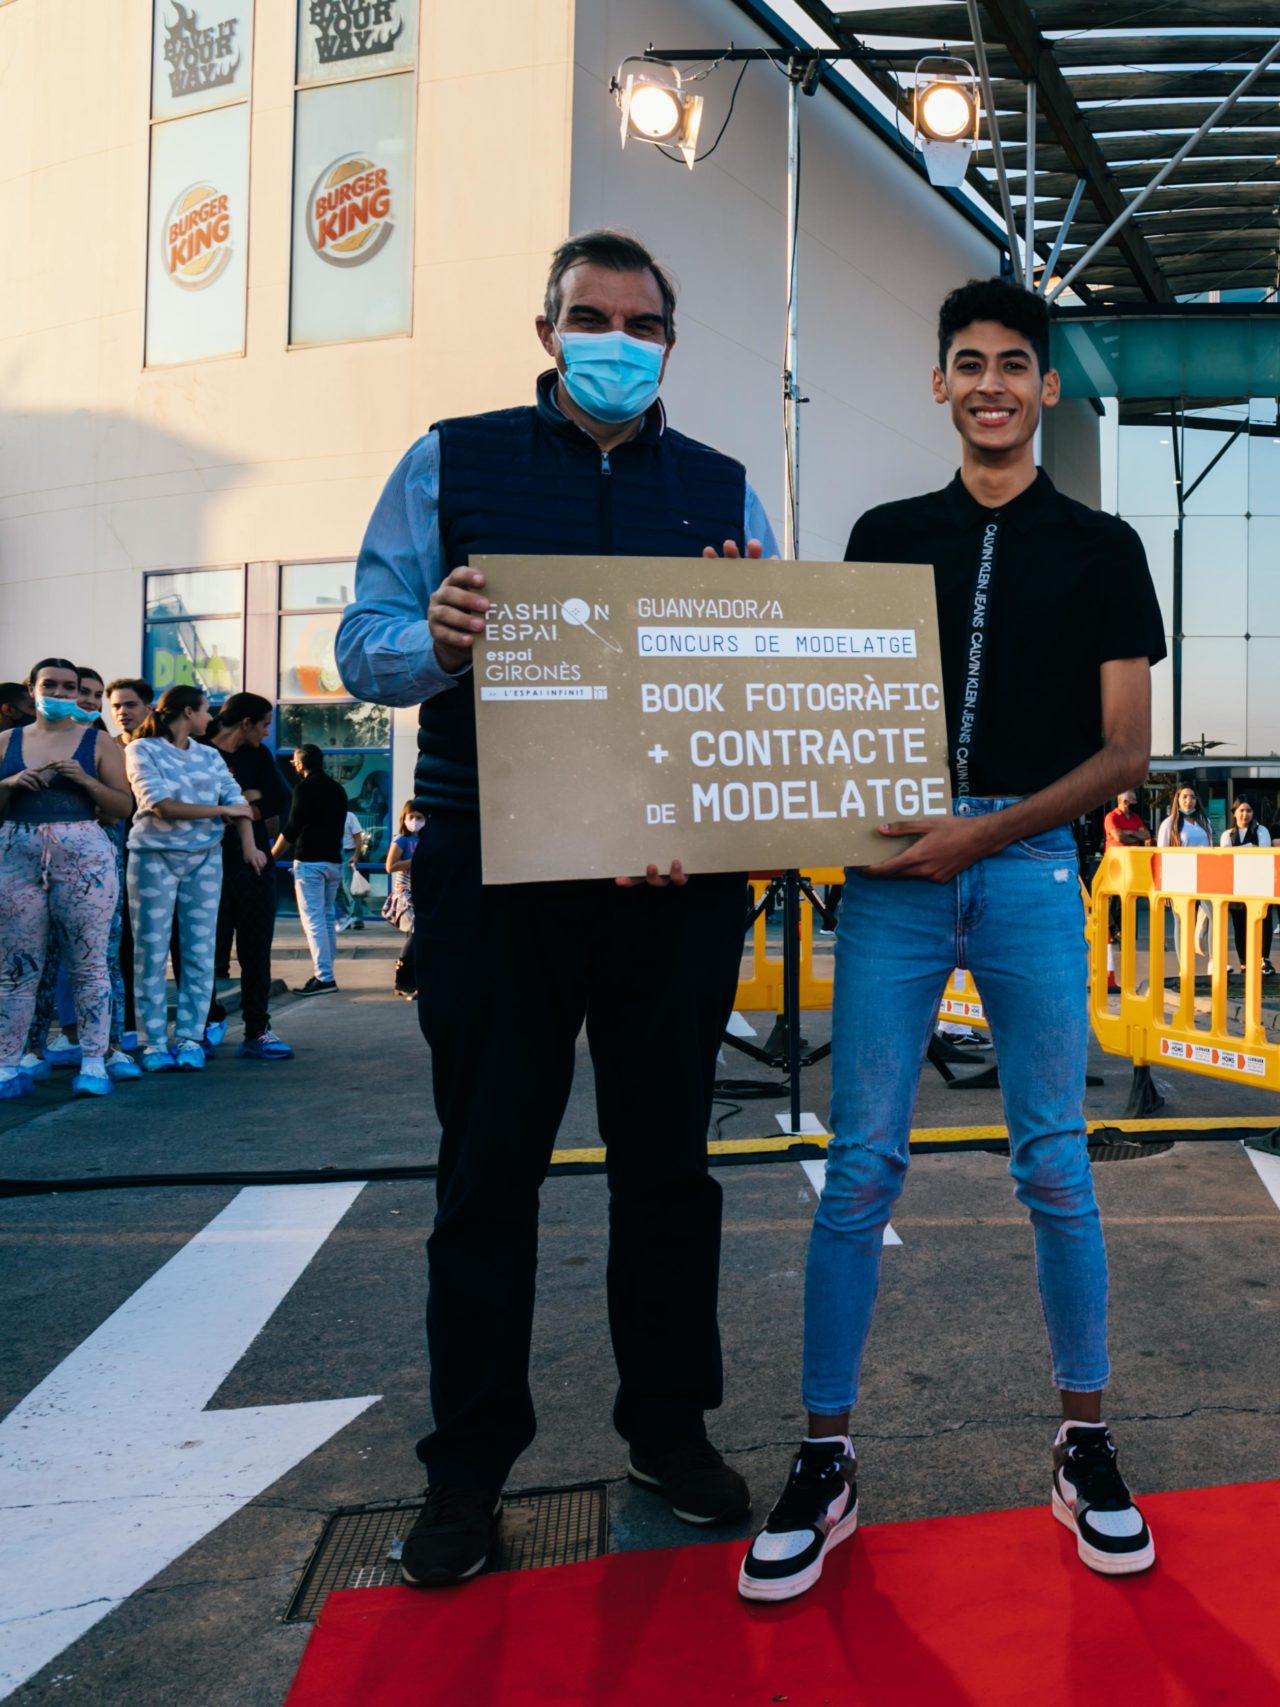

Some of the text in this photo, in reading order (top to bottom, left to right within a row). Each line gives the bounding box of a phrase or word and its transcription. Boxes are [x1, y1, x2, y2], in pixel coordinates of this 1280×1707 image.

[319, 0, 393, 38] YOUR
[164, 17, 238, 61] HAVE IT
[174, 36, 234, 73] YOUR
[315, 29, 374, 58] WAY
[168, 62, 217, 93] WAY
[315, 167, 387, 220] BURGER
[168, 194, 229, 246] BURGER
[317, 187, 391, 250] KING
[170, 213, 230, 273] KING
[981, 523, 998, 560] CALVIN
[976, 561, 992, 589] KLEIN
[637, 597, 784, 619] GUANYADOR/A
[971, 590, 987, 628] JEANS
[485, 624, 557, 641] ESPAI
[640, 634, 913, 654] CONCURS DE MODELATGE
[486, 648, 532, 664] espai
[486, 660, 582, 681] GIRONÈS
[968, 631, 983, 676] CALVIN
[504, 688, 584, 697] L'ESPAI INFINIT
[640, 673, 940, 713] BOOK FOTOGRÀFIC
[963, 676, 979, 708] KLEIN
[958, 709, 975, 744] JEANS
[690, 727, 928, 767] CONTRACTE
[646, 777, 948, 825] DE MODELATGE
